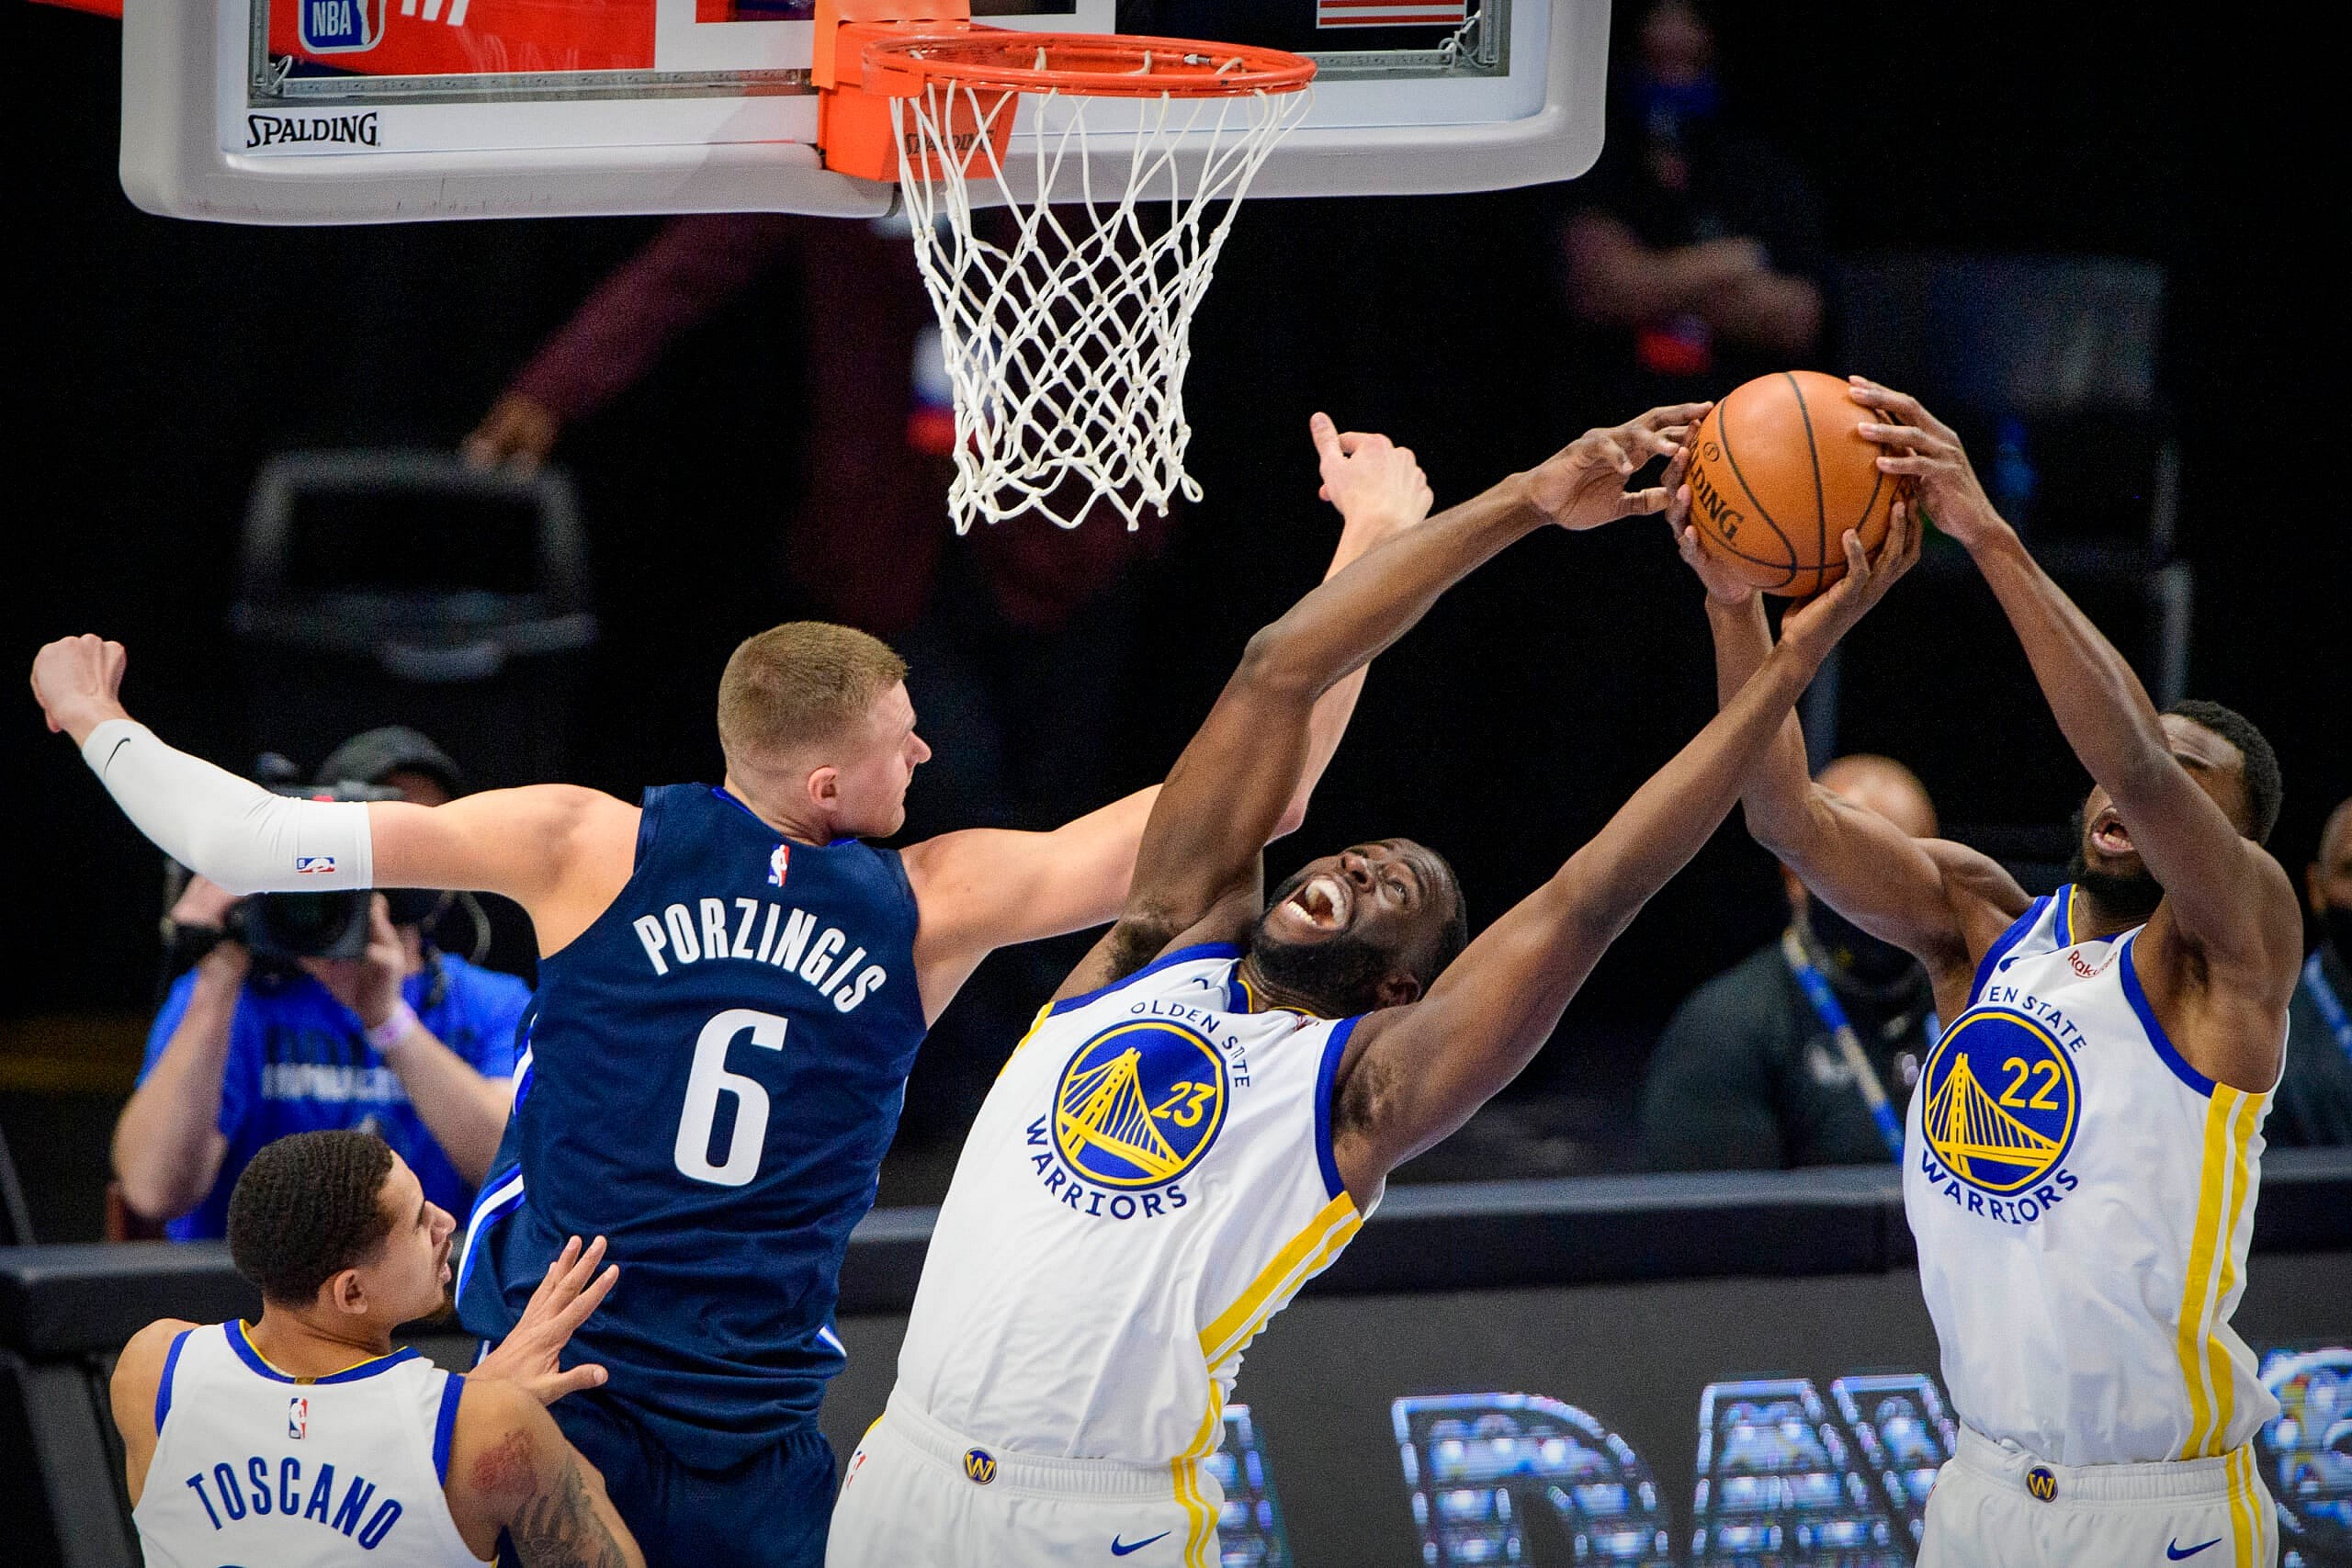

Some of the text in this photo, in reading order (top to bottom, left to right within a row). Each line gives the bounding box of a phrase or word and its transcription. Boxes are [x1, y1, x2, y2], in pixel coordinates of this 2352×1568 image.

[312, 1, 352, 38] NBA
[246, 111, 379, 149] SPALDING
[903, 130, 995, 156] SADING
[1690, 460, 1745, 542] DING
[632, 897, 888, 1013] PORZINGIS
[2067, 950, 2118, 978] Raku
[1130, 999, 1221, 1034] OLDEN
[2022, 996, 2087, 1053] STATE
[673, 1008, 789, 1187] 6
[1149, 1081, 1216, 1128] 23
[1998, 1056, 2062, 1111] 22
[1026, 1113, 1187, 1220] WARRIORS
[1920, 1148, 2080, 1225] WARRIORS
[964, 1451, 997, 1483] W
[2029, 1471, 2055, 1499] W
[186, 1456, 403, 1551] TOSCANO
